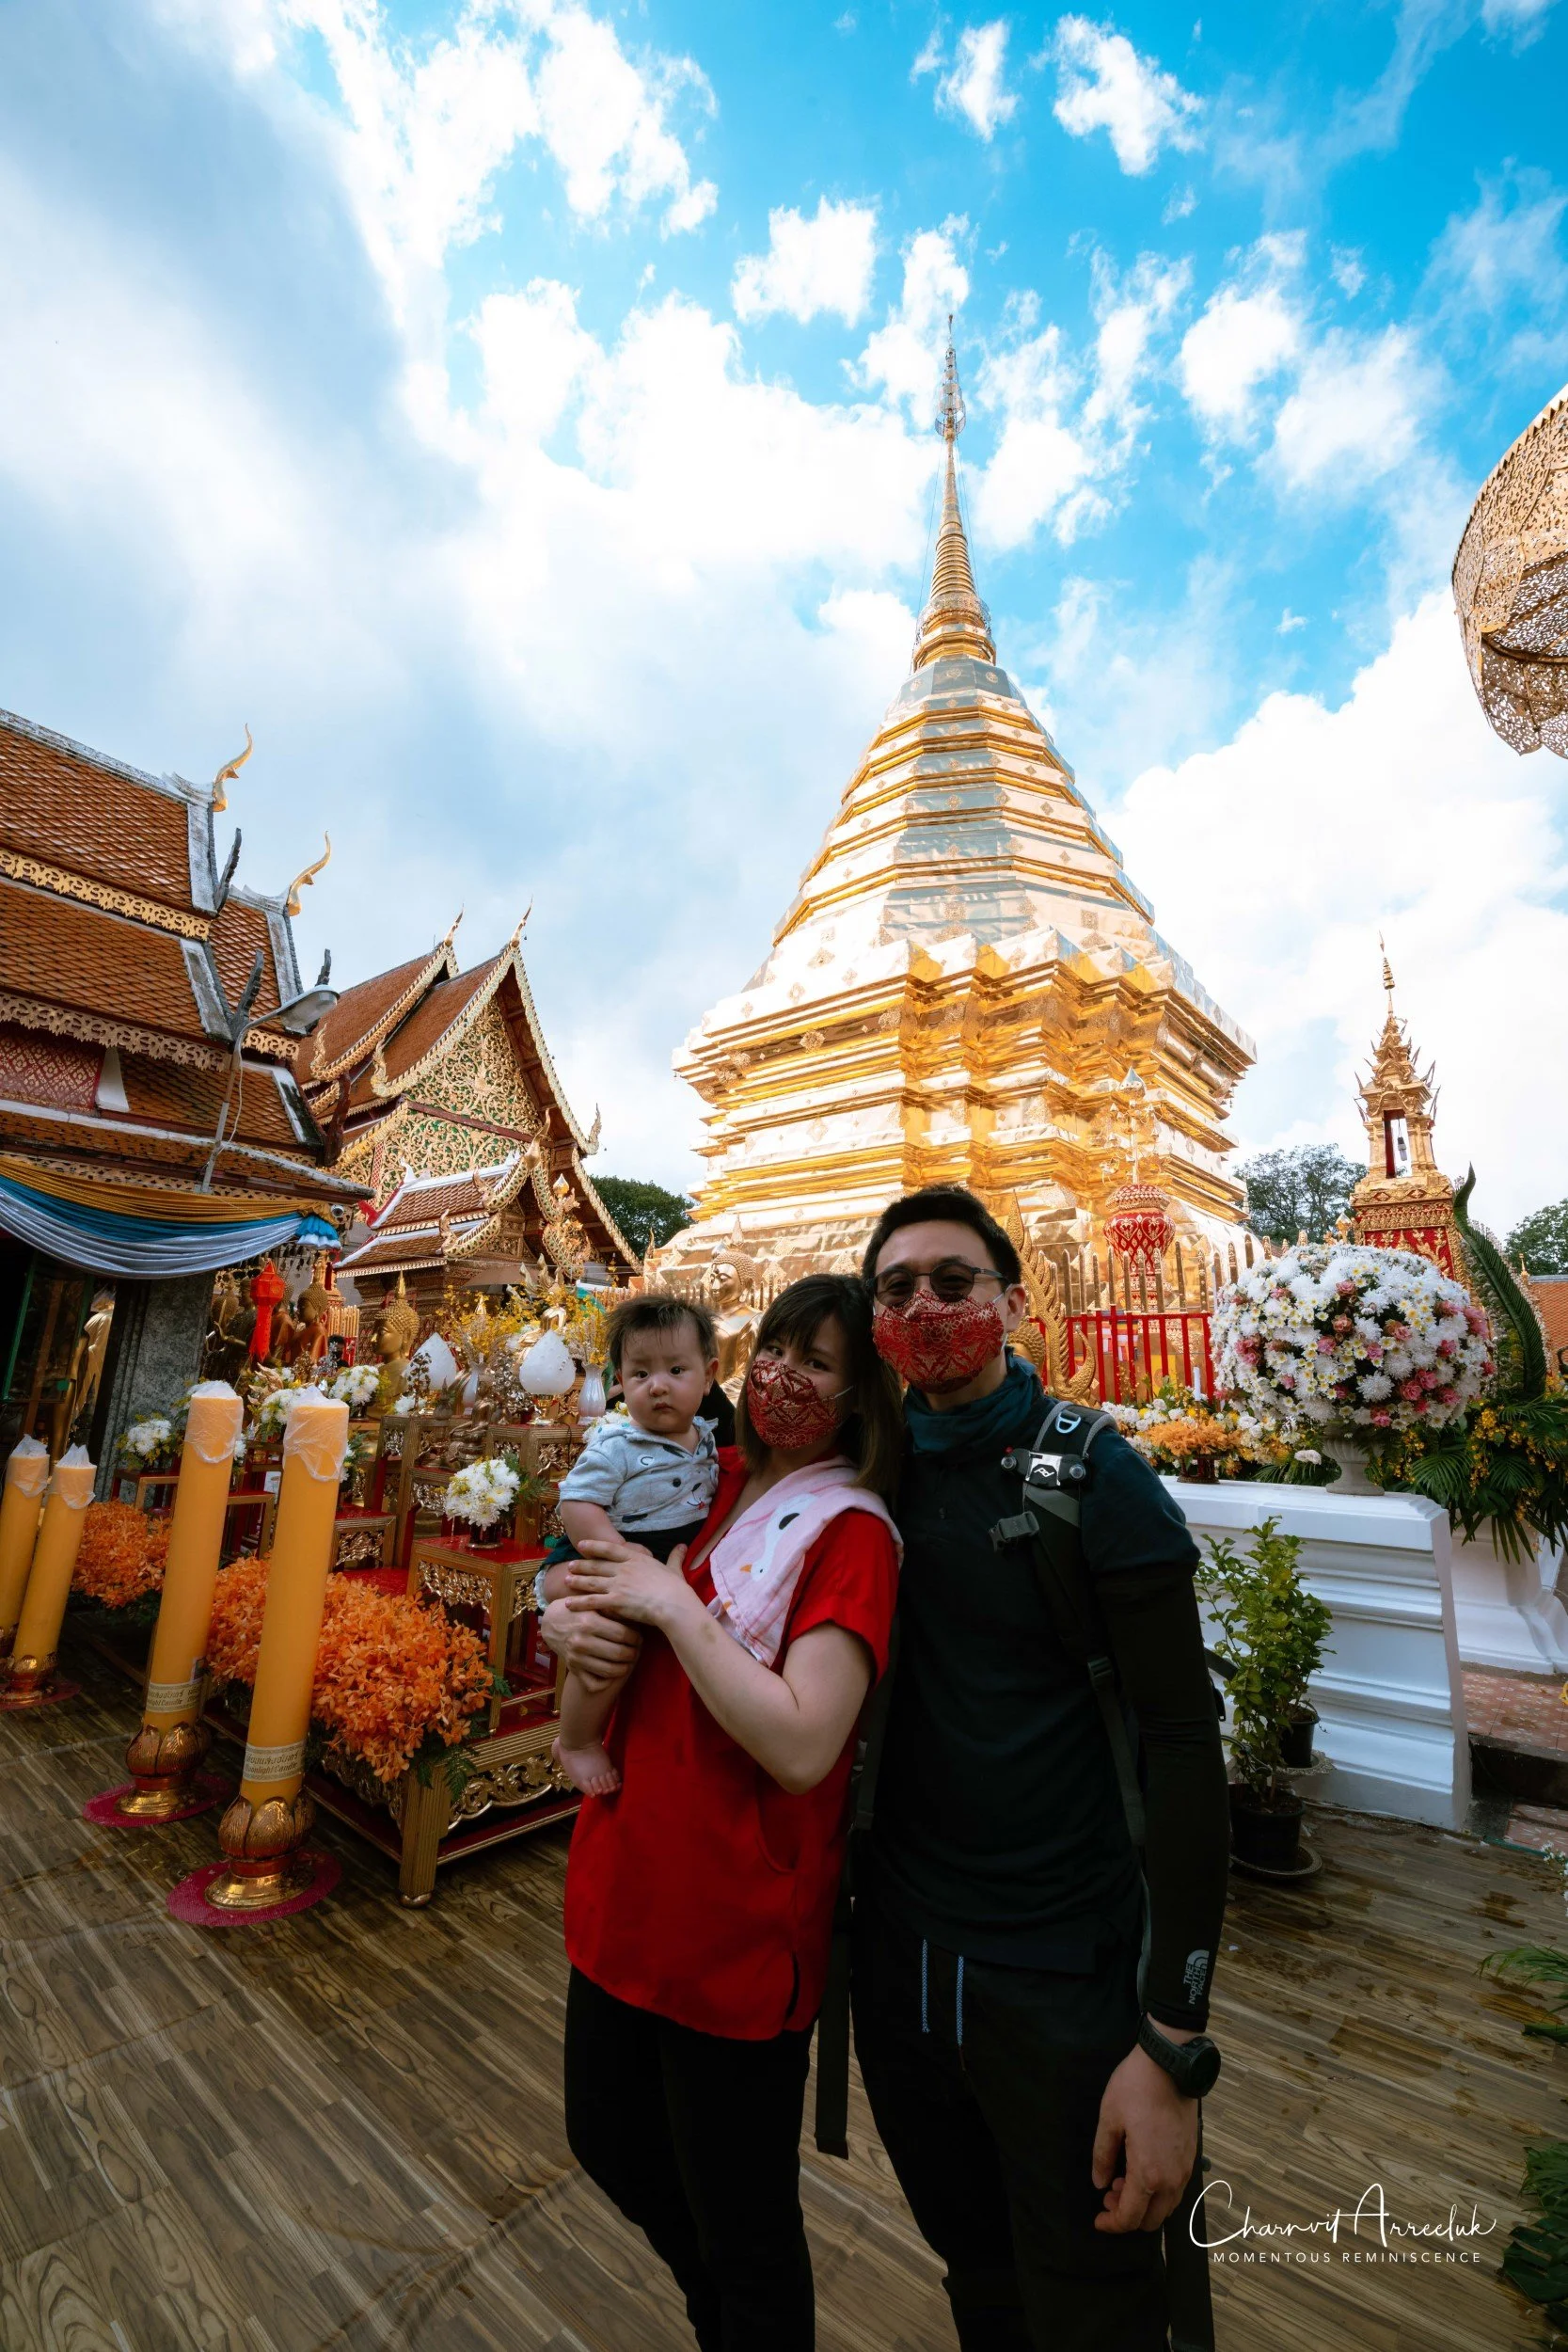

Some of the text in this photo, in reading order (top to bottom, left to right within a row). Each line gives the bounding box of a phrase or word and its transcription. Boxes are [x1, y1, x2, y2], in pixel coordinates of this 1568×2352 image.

[1183, 1963, 1194, 1985] THE
[1188, 1966, 1201, 2005] NORTH
[1196, 1968, 1207, 1995] FACE
